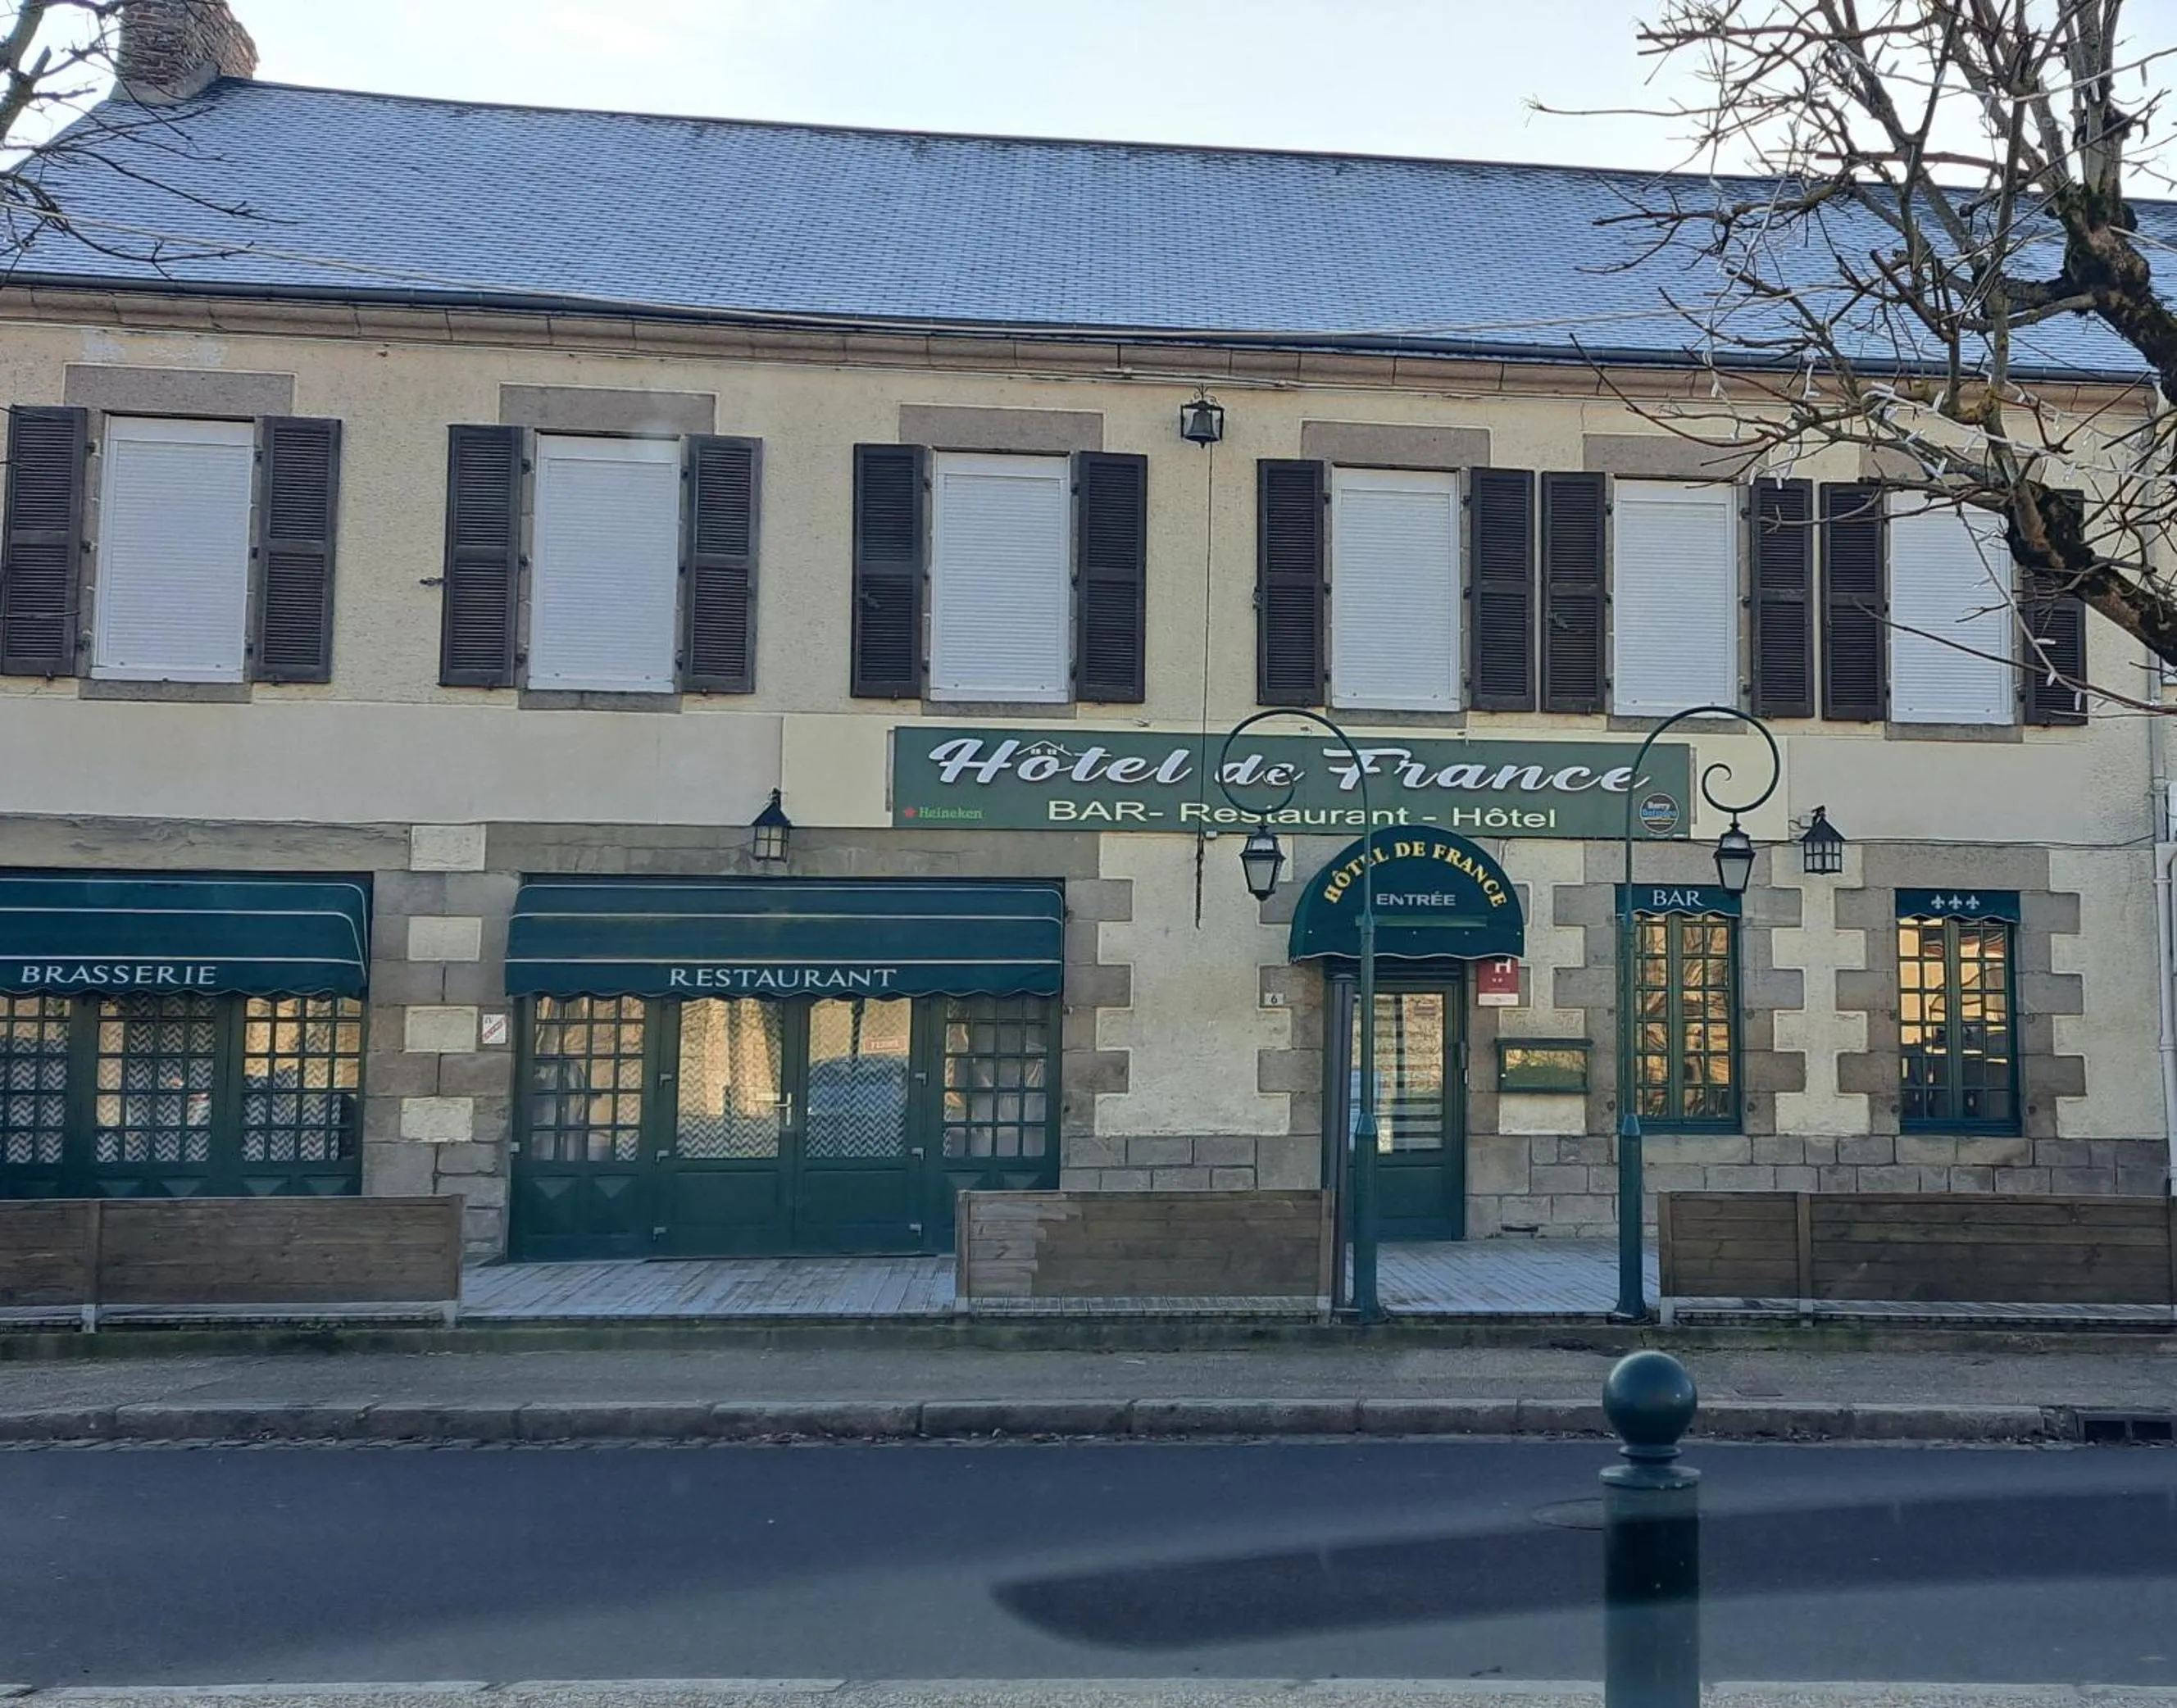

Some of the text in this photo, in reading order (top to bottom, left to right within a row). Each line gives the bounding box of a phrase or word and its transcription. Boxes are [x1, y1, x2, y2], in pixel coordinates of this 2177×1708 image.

[928, 738, 1651, 792] Hôtel de France
[919, 806, 984, 820] Heineken
[1180, 802, 1410, 826] Restaurant
[1452, 806, 1557, 829] Hôtel
[1393, 840, 1427, 859] DE
[1432, 843, 1508, 908] FRANCE
[1375, 890, 1457, 907] ENTRÉE
[1652, 888, 1706, 907] BAR
[20, 964, 217, 985] BRASSERIE
[669, 967, 898, 988] RESTAURANT
[1270, 993, 1278, 1005] 6
